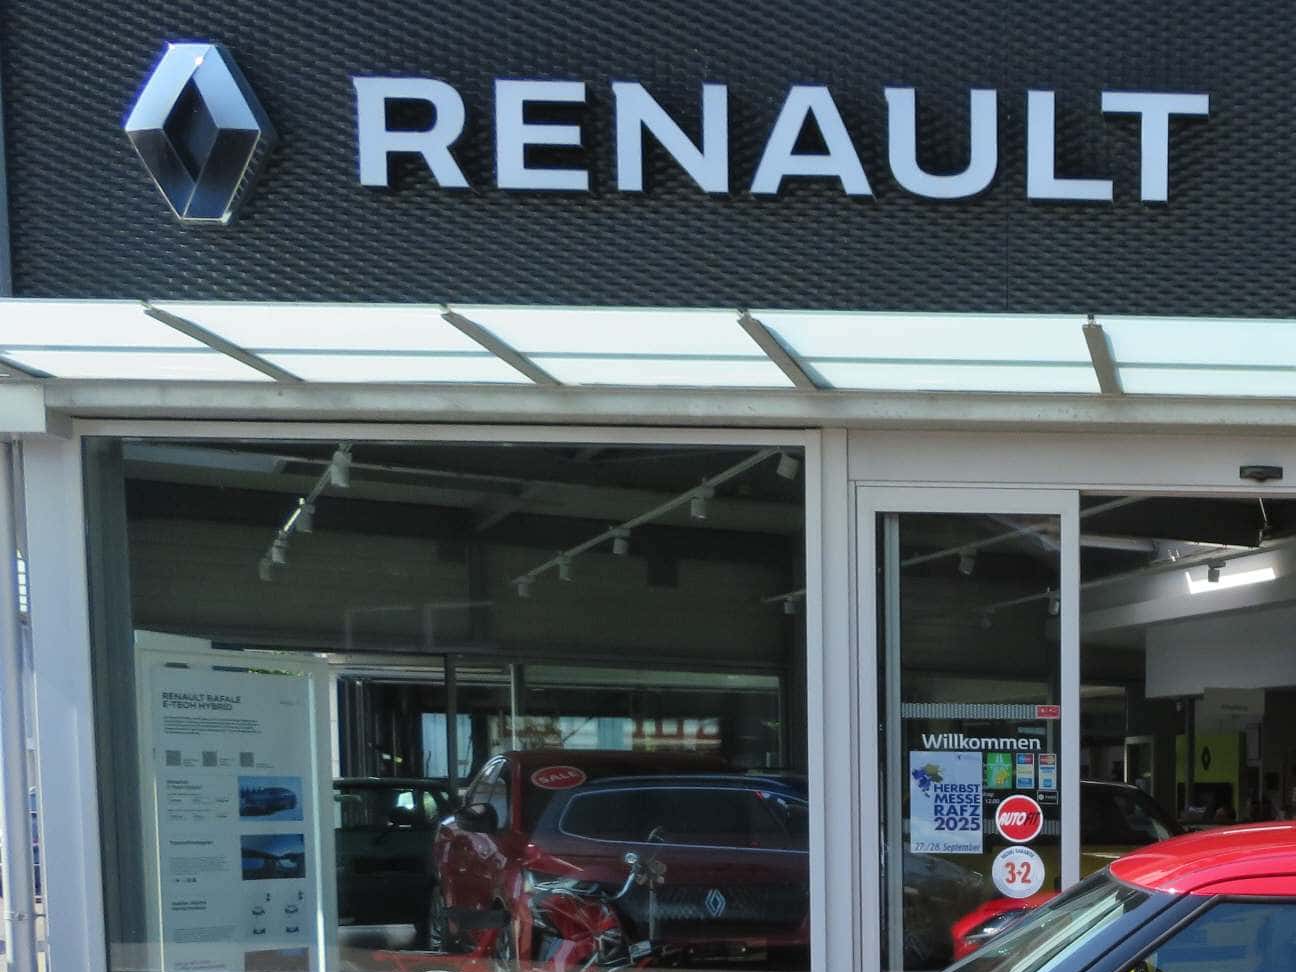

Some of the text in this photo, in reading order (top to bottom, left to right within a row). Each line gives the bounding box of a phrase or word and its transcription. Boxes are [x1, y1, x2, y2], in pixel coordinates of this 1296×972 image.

[353, 76, 1209, 201] RENAULT
[162, 692, 204, 702] RENAULT
[198, 702, 233, 711] HYBRID
[922, 733, 1041, 750] Willkommen
[934, 783, 980, 793] HERBST
[934, 793, 981, 804] MESSE
[934, 804, 980, 817] RAFZ
[934, 817, 980, 831] 2025
[943, 841, 980, 853] September
